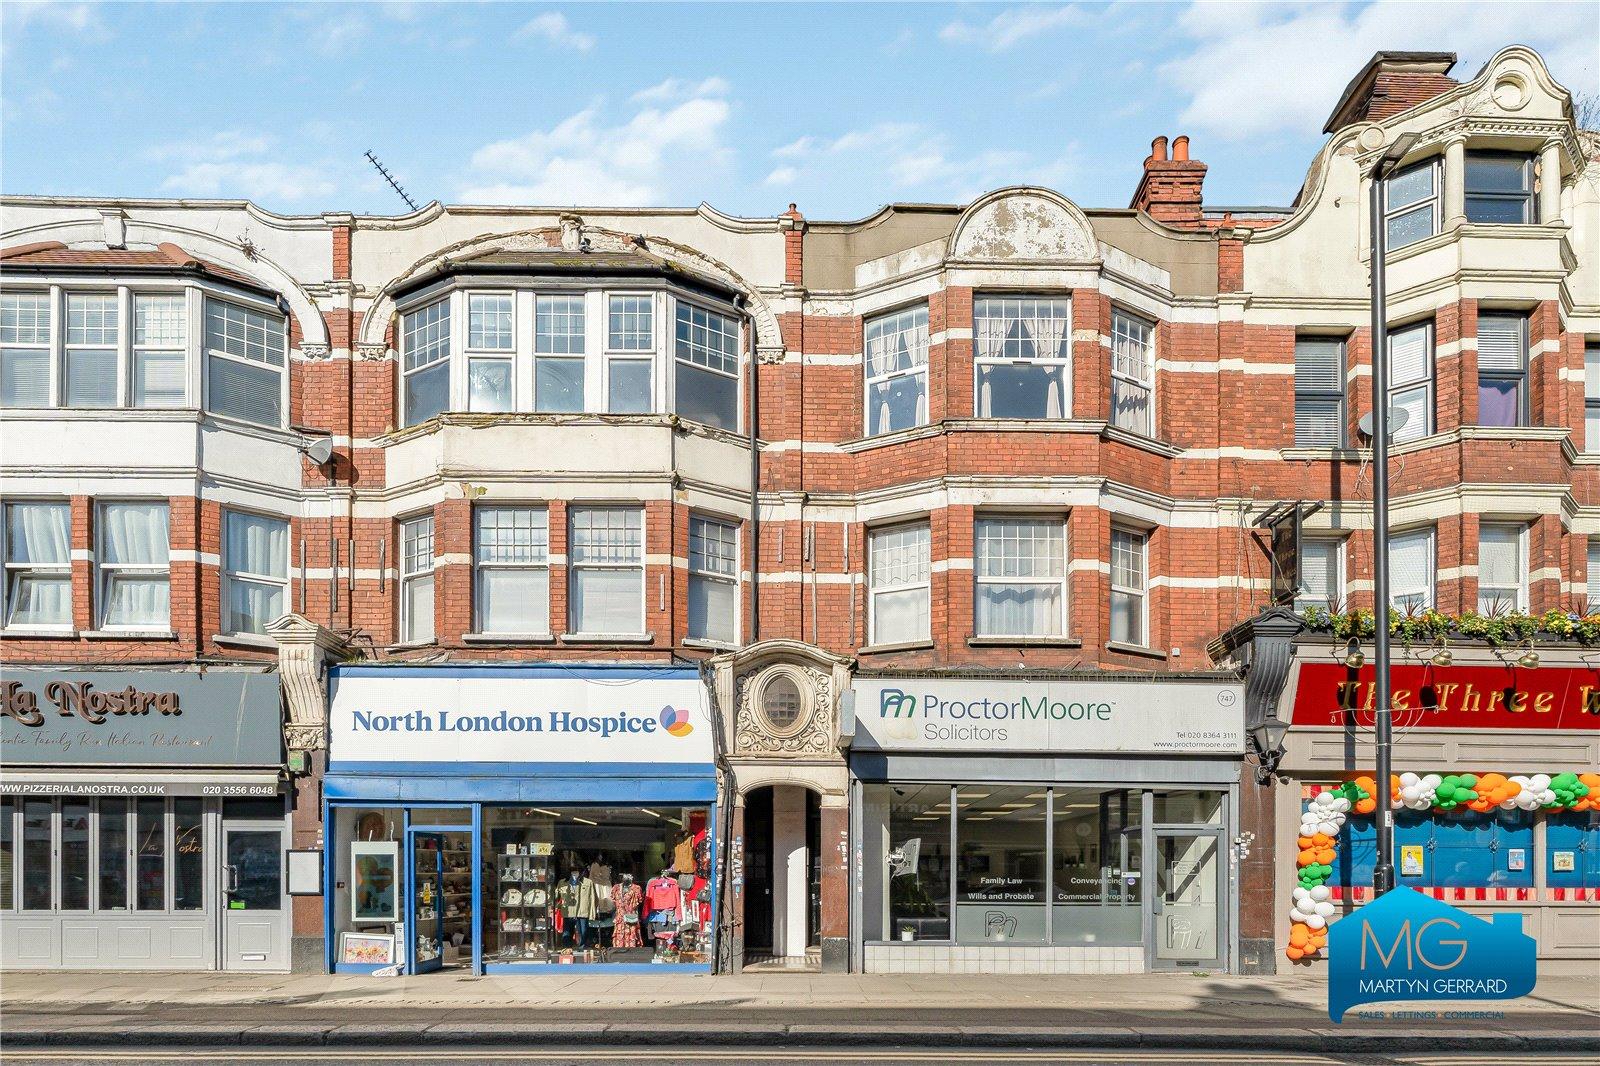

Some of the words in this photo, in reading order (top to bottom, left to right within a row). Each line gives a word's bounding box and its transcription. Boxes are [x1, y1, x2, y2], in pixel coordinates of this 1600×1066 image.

[44, 680, 183, 724] Nostra
[1436, 683, 1554, 713] Three
[352, 709, 433, 732] North
[438, 710, 543, 732] London
[549, 711, 657, 738] Hospice
[924, 723, 1008, 741] Solicitors
[1153, 741, 1238, 749] www.proctormoore.com
[0, 784, 165, 795] WW.PIZZERIALANOSTRA.CO.UK
[203, 786, 221, 795] 020
[223, 786, 247, 795] 3556
[249, 786, 274, 795] 6048
[980, 877, 1005, 886] Family
[1007, 877, 1023, 885] Law
